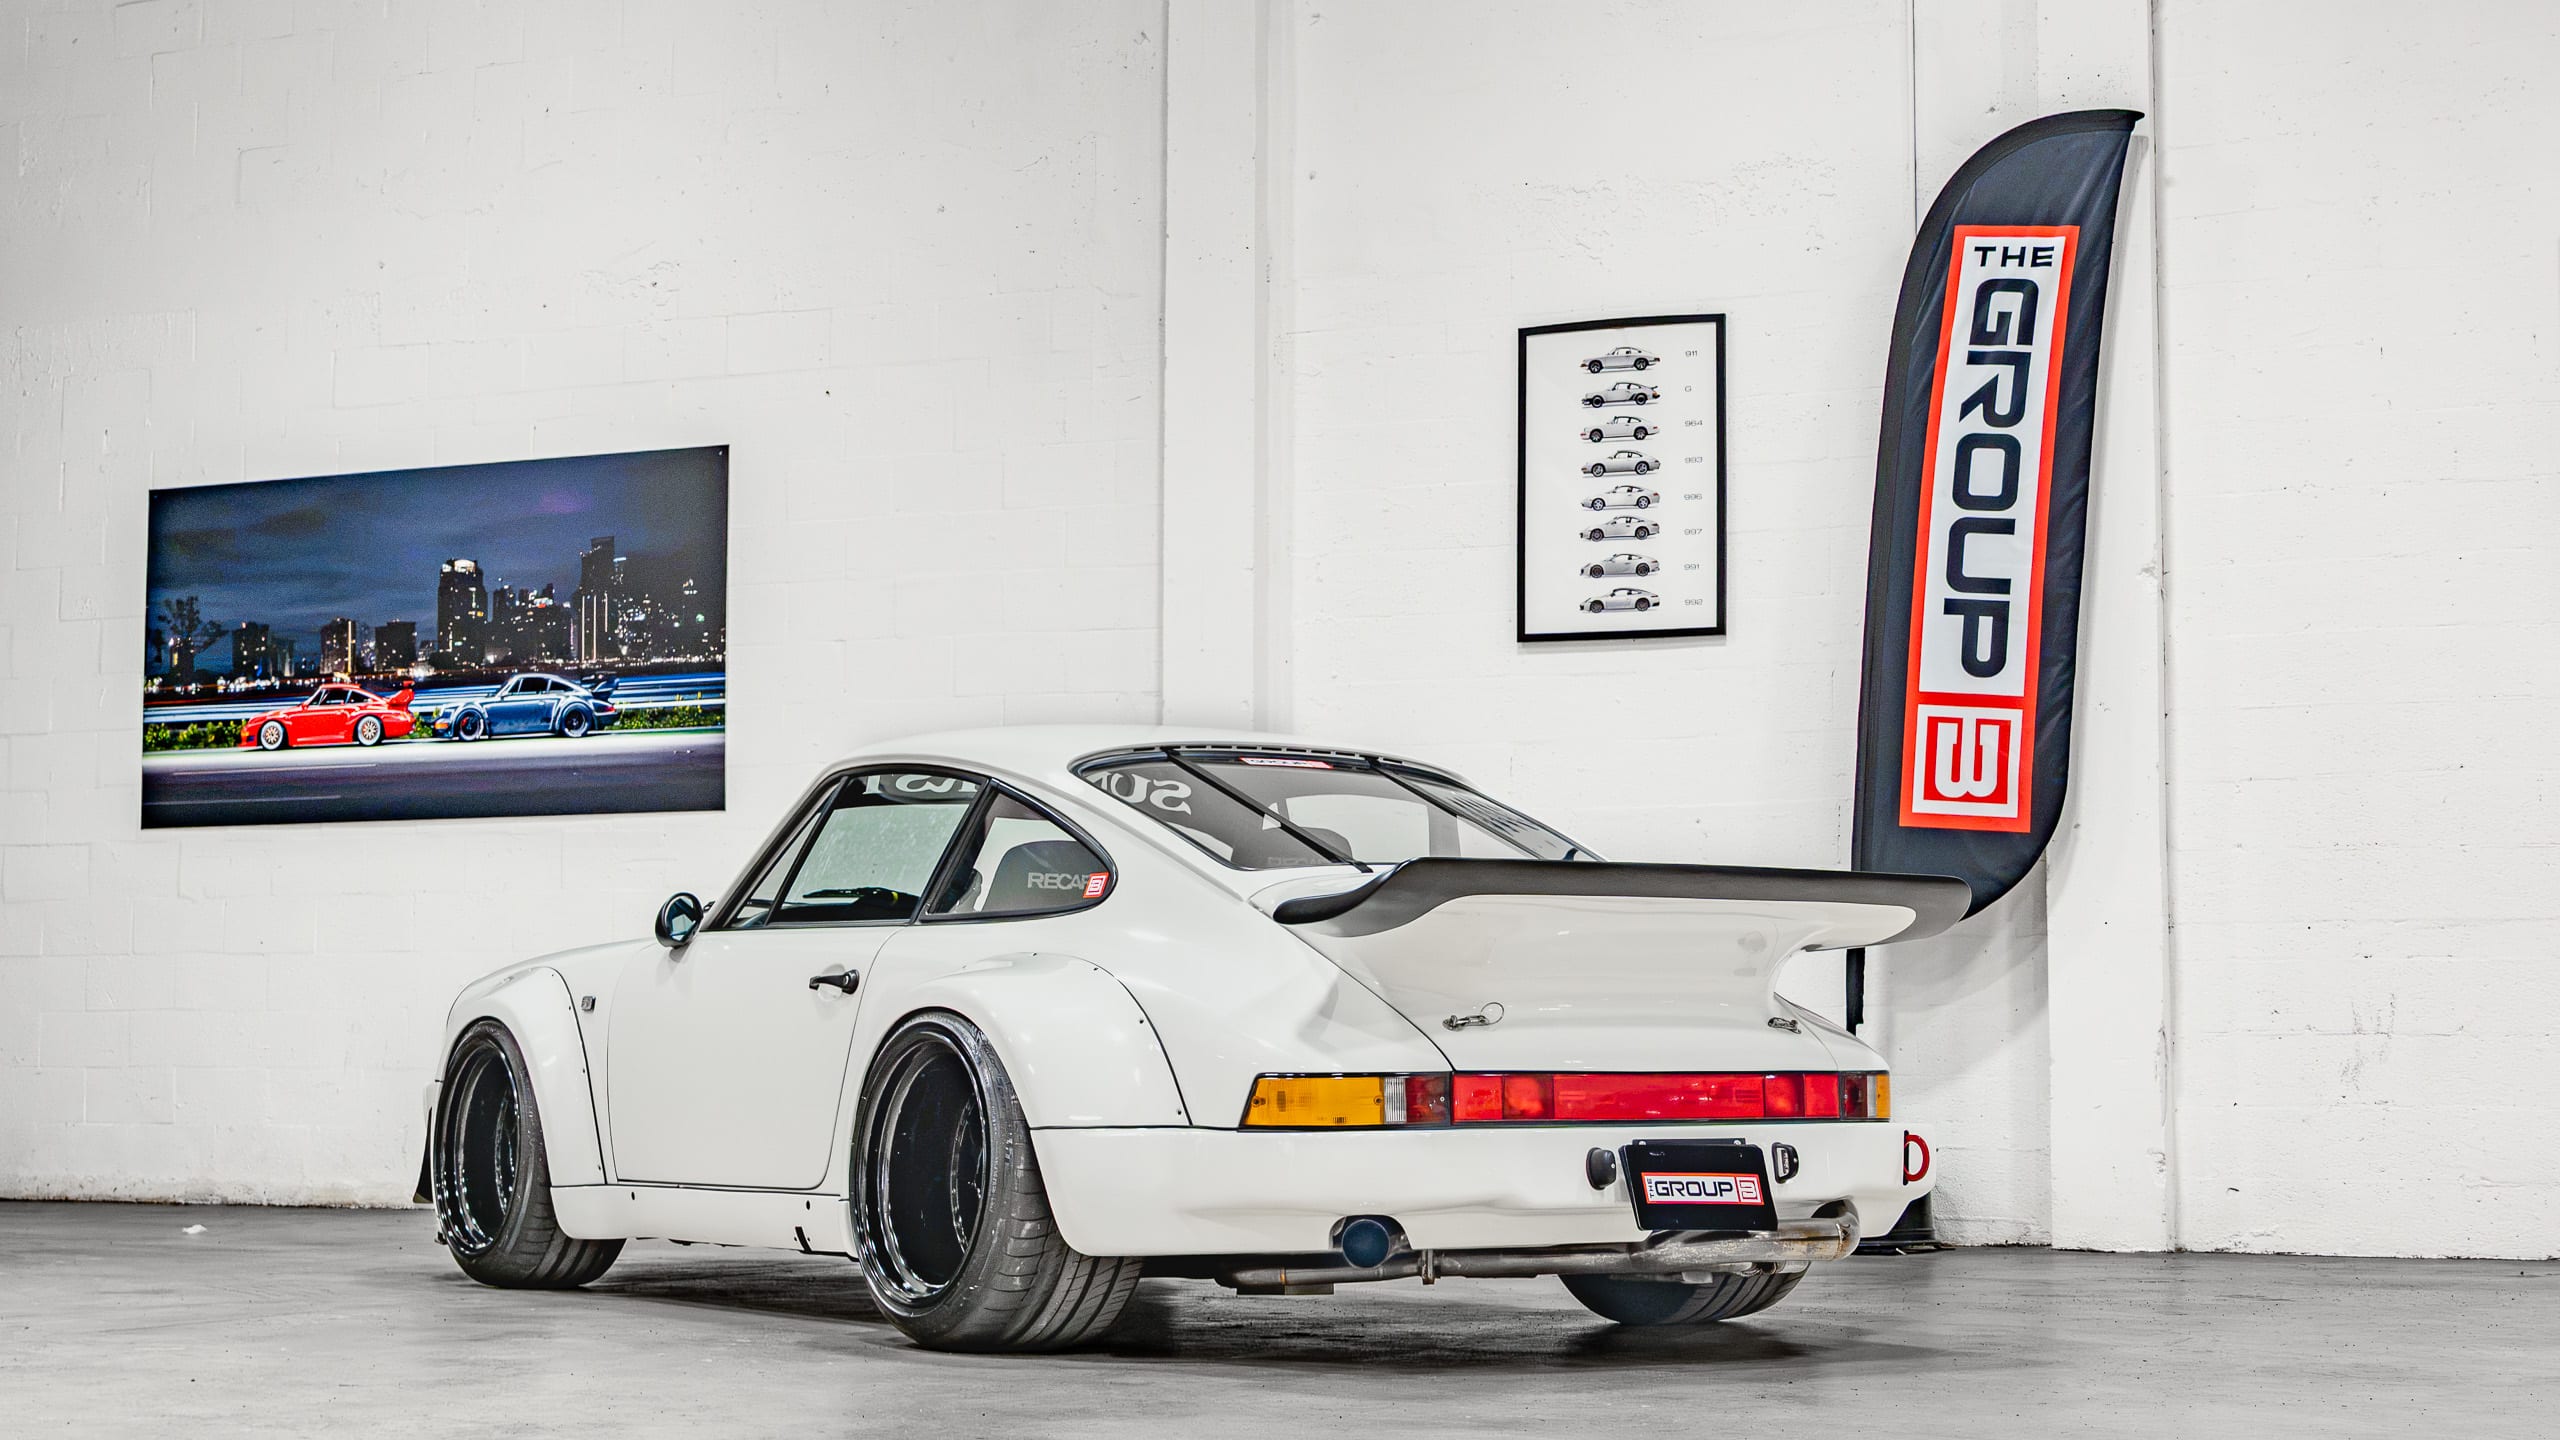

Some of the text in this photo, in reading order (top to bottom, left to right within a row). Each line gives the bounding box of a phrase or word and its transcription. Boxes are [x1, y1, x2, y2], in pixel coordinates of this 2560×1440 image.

[1973, 246, 2055, 268] THE
[1943, 278, 2040, 678] GROUP
[1654, 1180, 1733, 1197] GROUP
